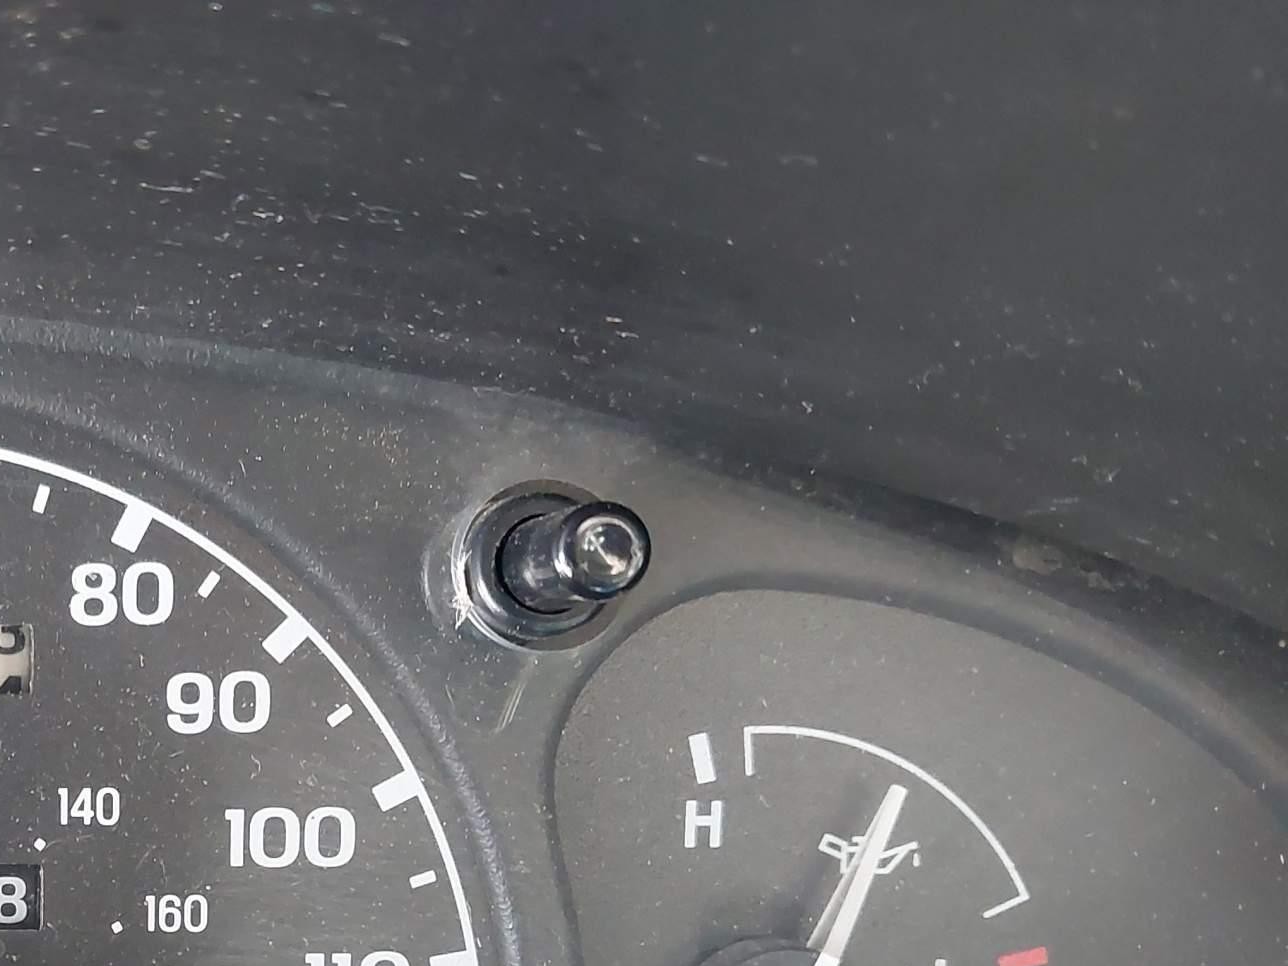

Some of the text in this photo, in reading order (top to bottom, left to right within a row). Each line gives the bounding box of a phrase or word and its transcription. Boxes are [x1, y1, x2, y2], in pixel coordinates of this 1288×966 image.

[69, 562, 175, 626] 80
[166, 671, 270, 733] 90
[58, 787, 120, 826] 140
[685, 800, 721, 848] H
[225, 806, 355, 868] 100
[145, 895, 208, 933] 160
